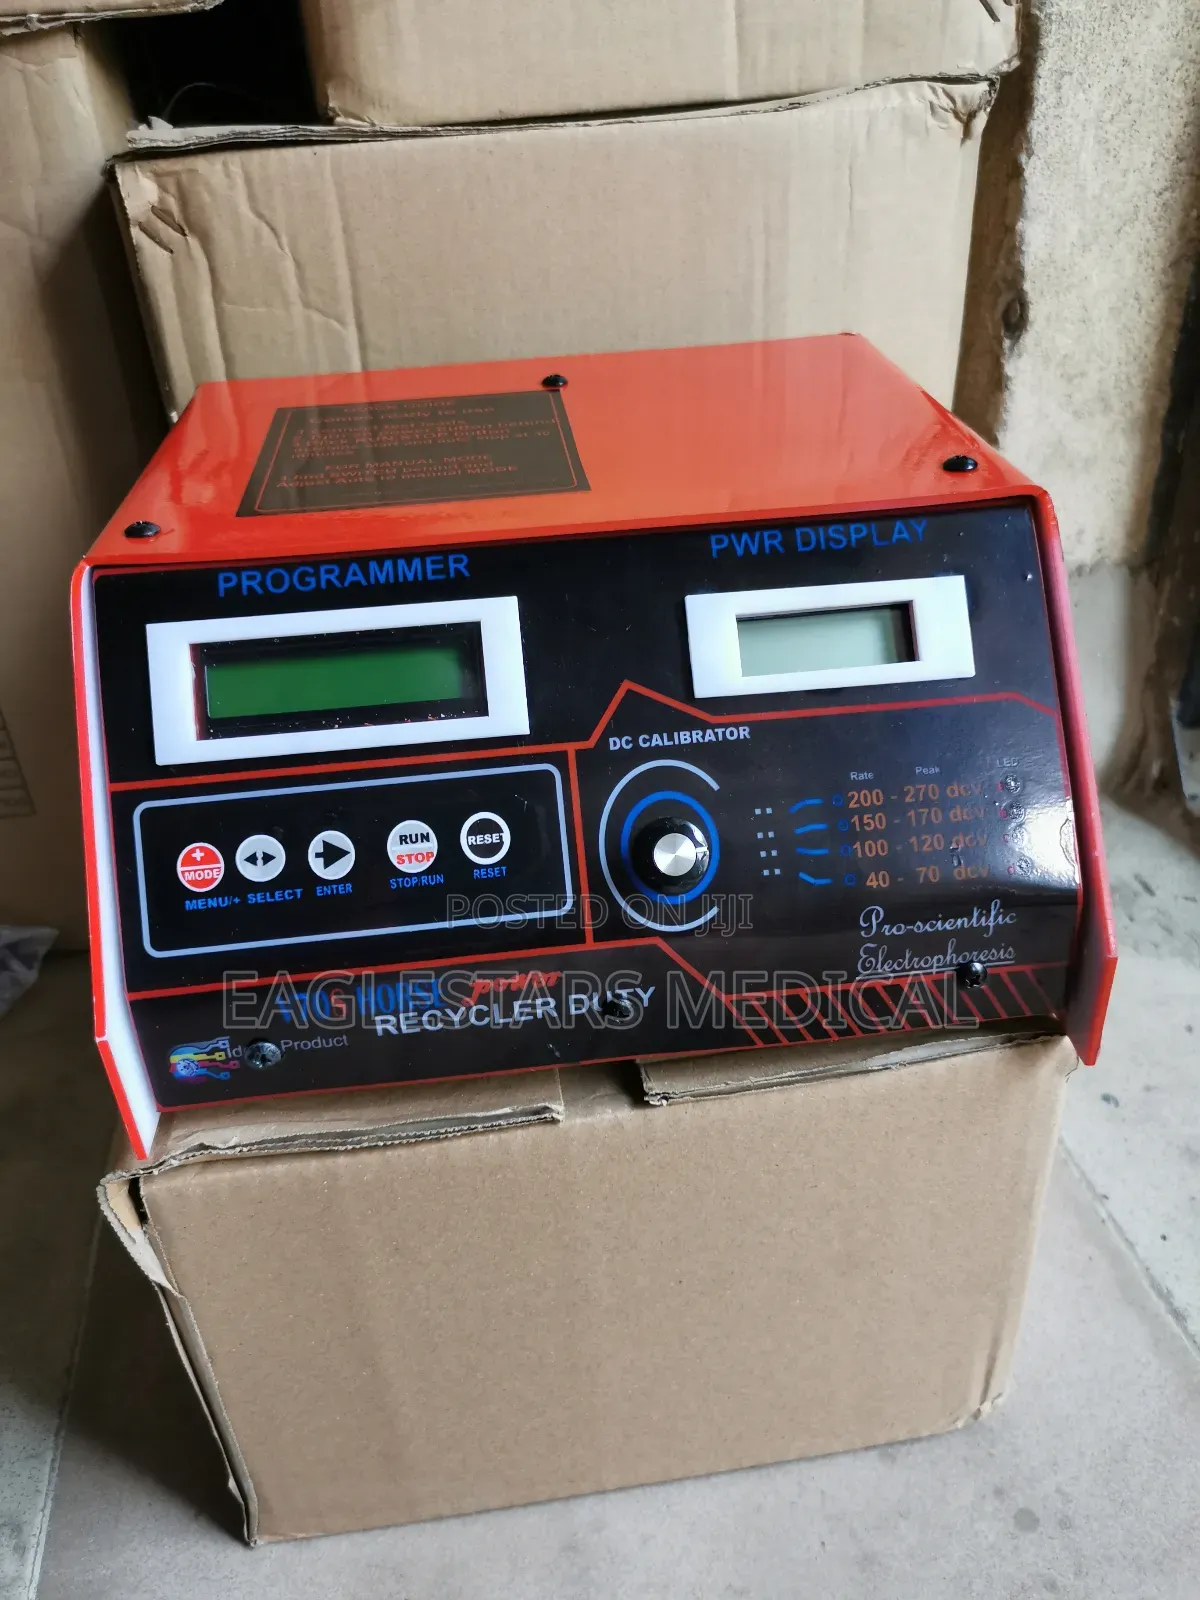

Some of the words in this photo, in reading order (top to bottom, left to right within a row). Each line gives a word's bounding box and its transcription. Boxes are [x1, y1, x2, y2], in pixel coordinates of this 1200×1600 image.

[710, 528, 786, 558] PWR
[795, 519, 928, 552] DISPLAY
[217, 554, 470, 598] PROGRAMMER
[608, 735, 633, 750] DC
[637, 725, 751, 748] CALIBRATOR
[850, 770, 874, 782] Rate
[915, 765, 941, 775] Peak
[848, 788, 884, 809] 200
[904, 783, 940, 803] 270
[851, 812, 887, 832] 150
[908, 807, 942, 826] 170
[398, 832, 430, 845] RUN
[467, 832, 505, 846] RESET
[853, 839, 888, 858] 100
[909, 833, 944, 853] 120
[396, 851, 435, 865] STOP
[184, 867, 222, 881] MODE
[390, 873, 444, 890] STOP/RUN
[473, 866, 508, 880] RESET
[865, 870, 890, 889] 40
[916, 865, 940, 884] 70
[247, 888, 303, 905] SELECT
[316, 882, 353, 897] ENTER
[859, 899, 1017, 938] Pro-scientific
[856, 938, 1016, 975] Electrophoresis
[374, 998, 558, 1037] RECYCLER
[568, 986, 656, 1016] DUTY
[280, 1034, 349, 1052] Product
